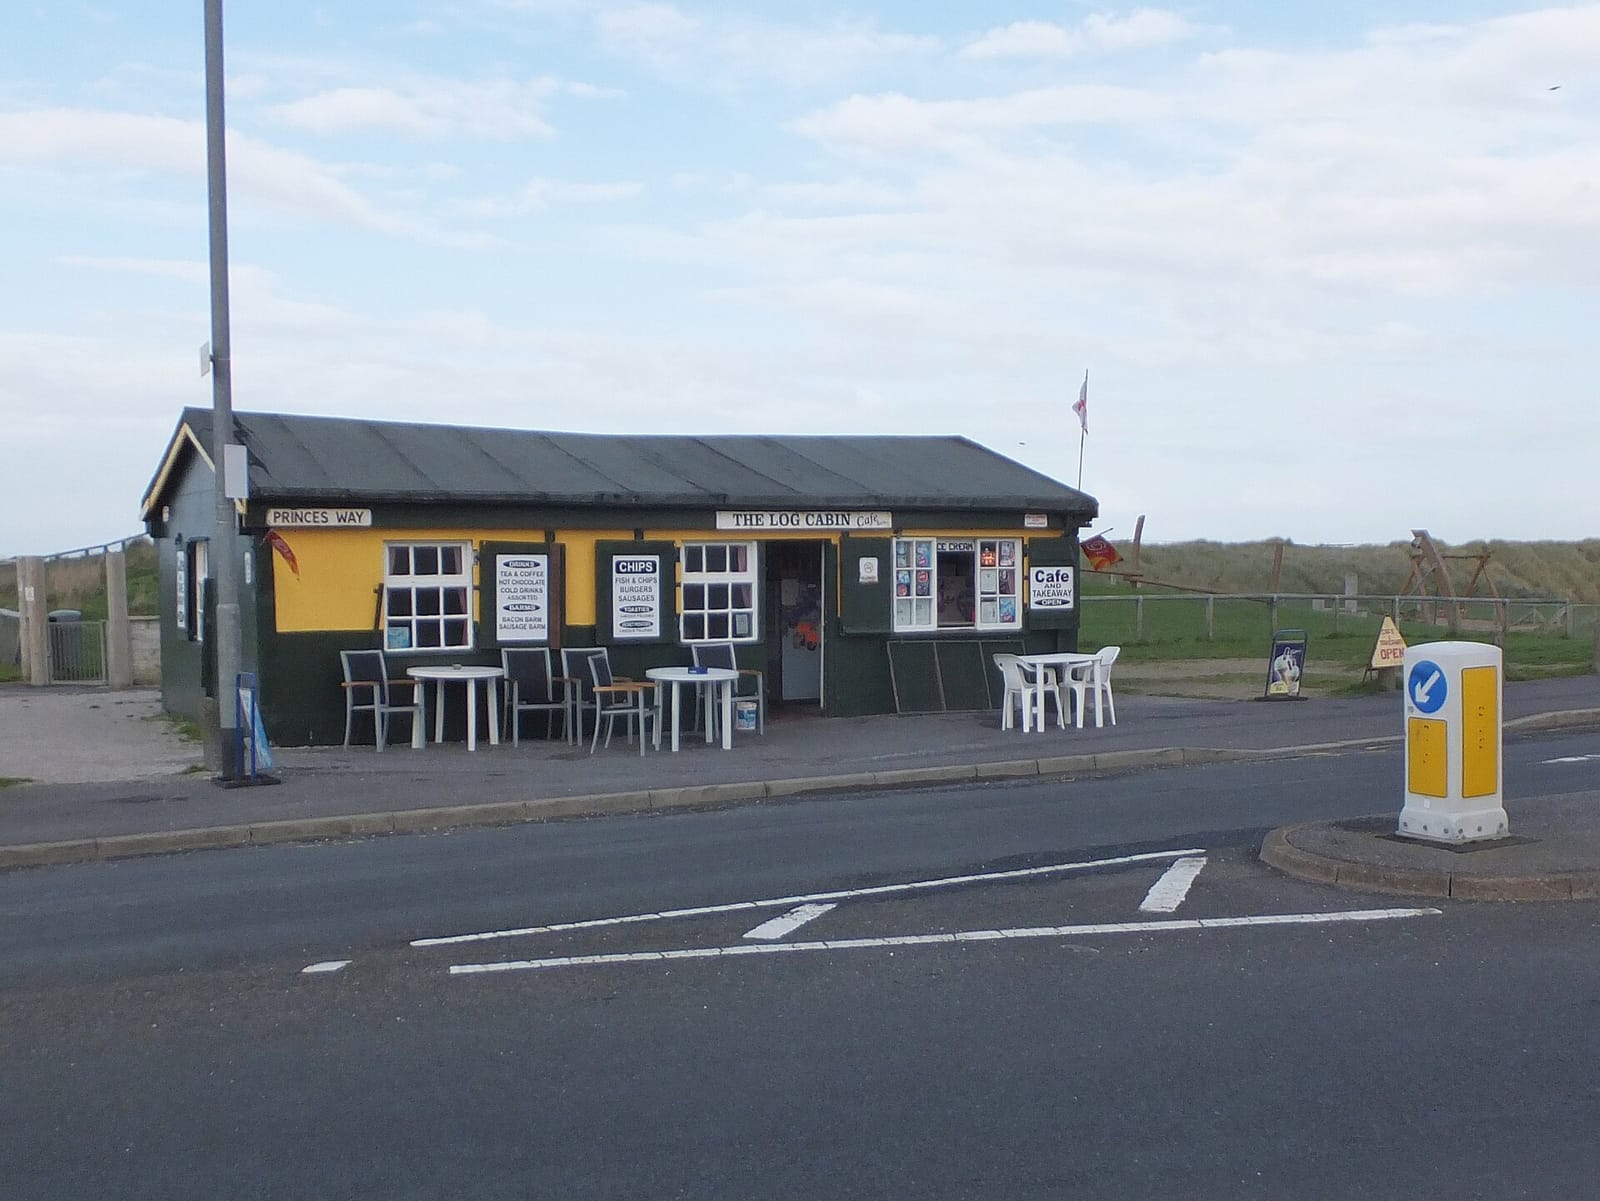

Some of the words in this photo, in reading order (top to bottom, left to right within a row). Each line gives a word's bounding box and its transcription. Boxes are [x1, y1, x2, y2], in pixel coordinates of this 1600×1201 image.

[273, 511, 329, 523] PRINCES
[336, 511, 364, 523] WAY
[733, 513, 765, 526] THE
[768, 513, 800, 526] LOG
[805, 513, 850, 526] CABIN
[949, 542, 975, 551] CREAM
[619, 562, 653, 572] CHIPS
[1035, 569, 1069, 583] Cafe
[618, 594, 655, 602] SAUSAGES
[1032, 589, 1072, 598] TAKEAWAY
